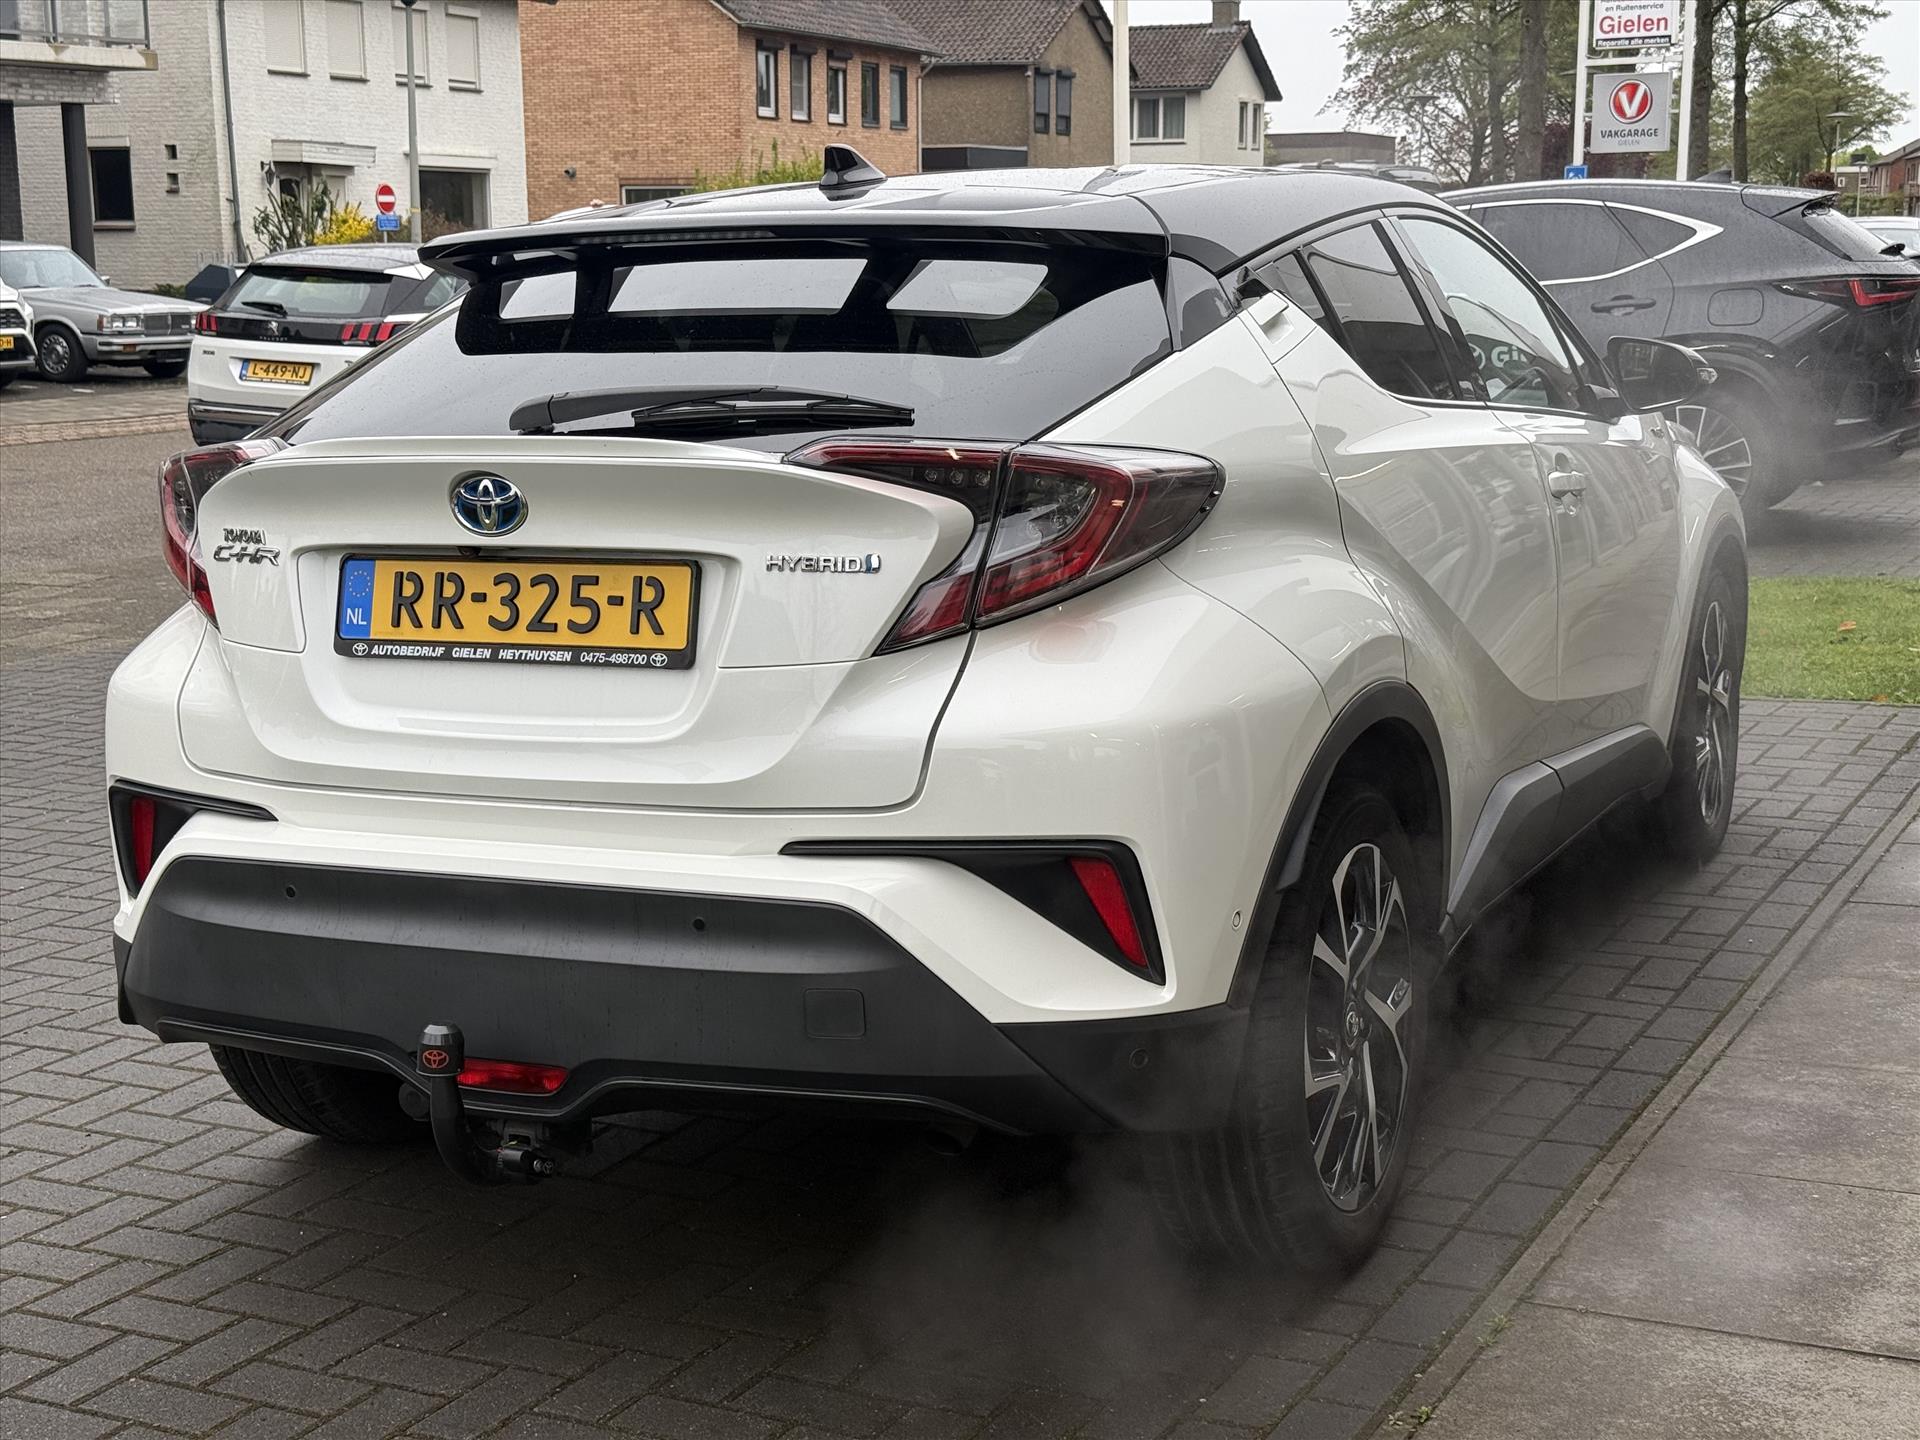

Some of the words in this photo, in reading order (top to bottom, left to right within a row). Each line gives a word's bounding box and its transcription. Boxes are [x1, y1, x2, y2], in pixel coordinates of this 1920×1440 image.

[1599, 15, 1668, 34] Gielen
[1597, 39, 1629, 47] Reparatie
[1600, 128, 1659, 138] VAKGARAGE
[252, 363, 307, 379] L-449-NJ
[766, 554, 861, 573] HYBRID
[391, 571, 665, 635] RR-325-R
[346, 608, 367, 625] NL
[371, 644, 445, 657] AUTOBEDRIJF
[452, 647, 492, 659] GIELEN
[498, 648, 573, 662] HEYTHUYSEN
[580, 652, 647, 665] 0475-498700
